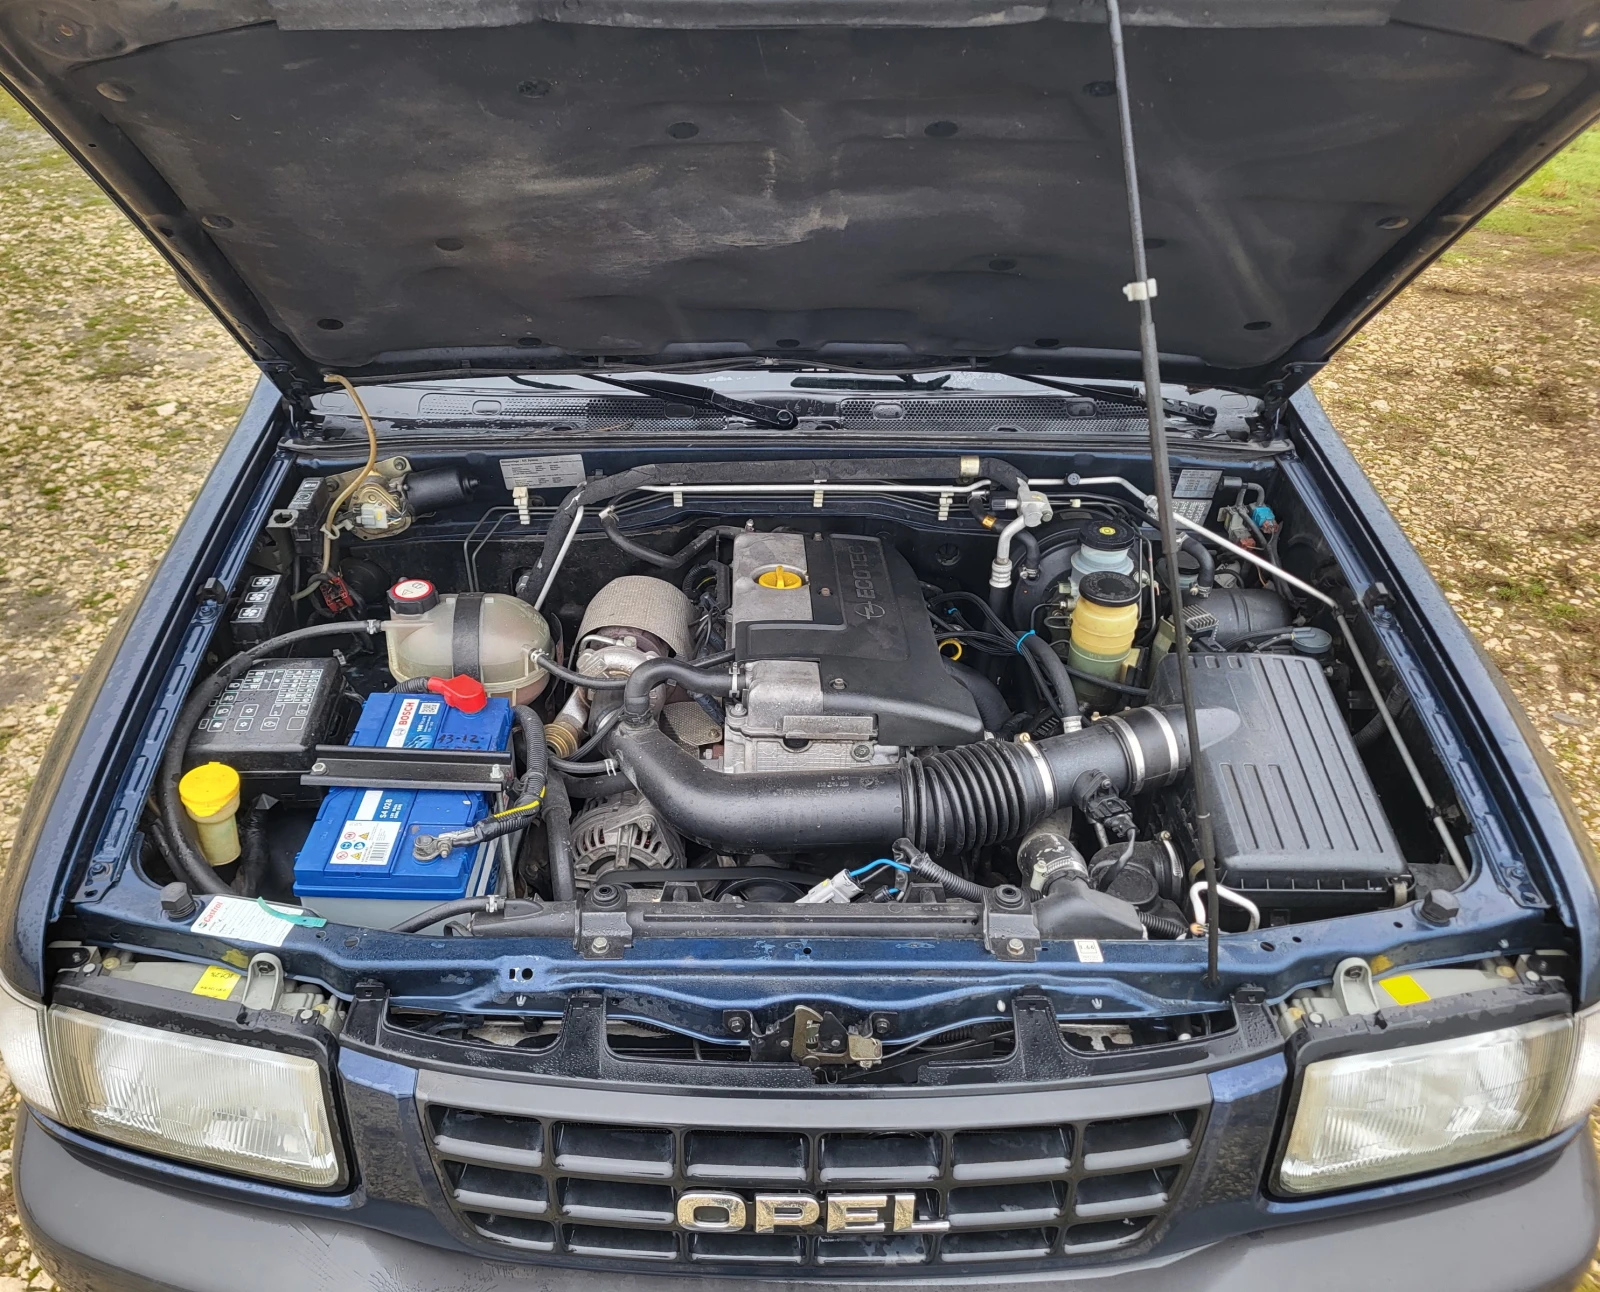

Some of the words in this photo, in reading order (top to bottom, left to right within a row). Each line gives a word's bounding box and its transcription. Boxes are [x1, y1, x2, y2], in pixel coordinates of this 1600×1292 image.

[848, 545, 876, 599] ECOTEC
[398, 702, 415, 726] BOSCH
[203, 901, 224, 923] Castrol
[676, 1190, 950, 1234] OPEL
